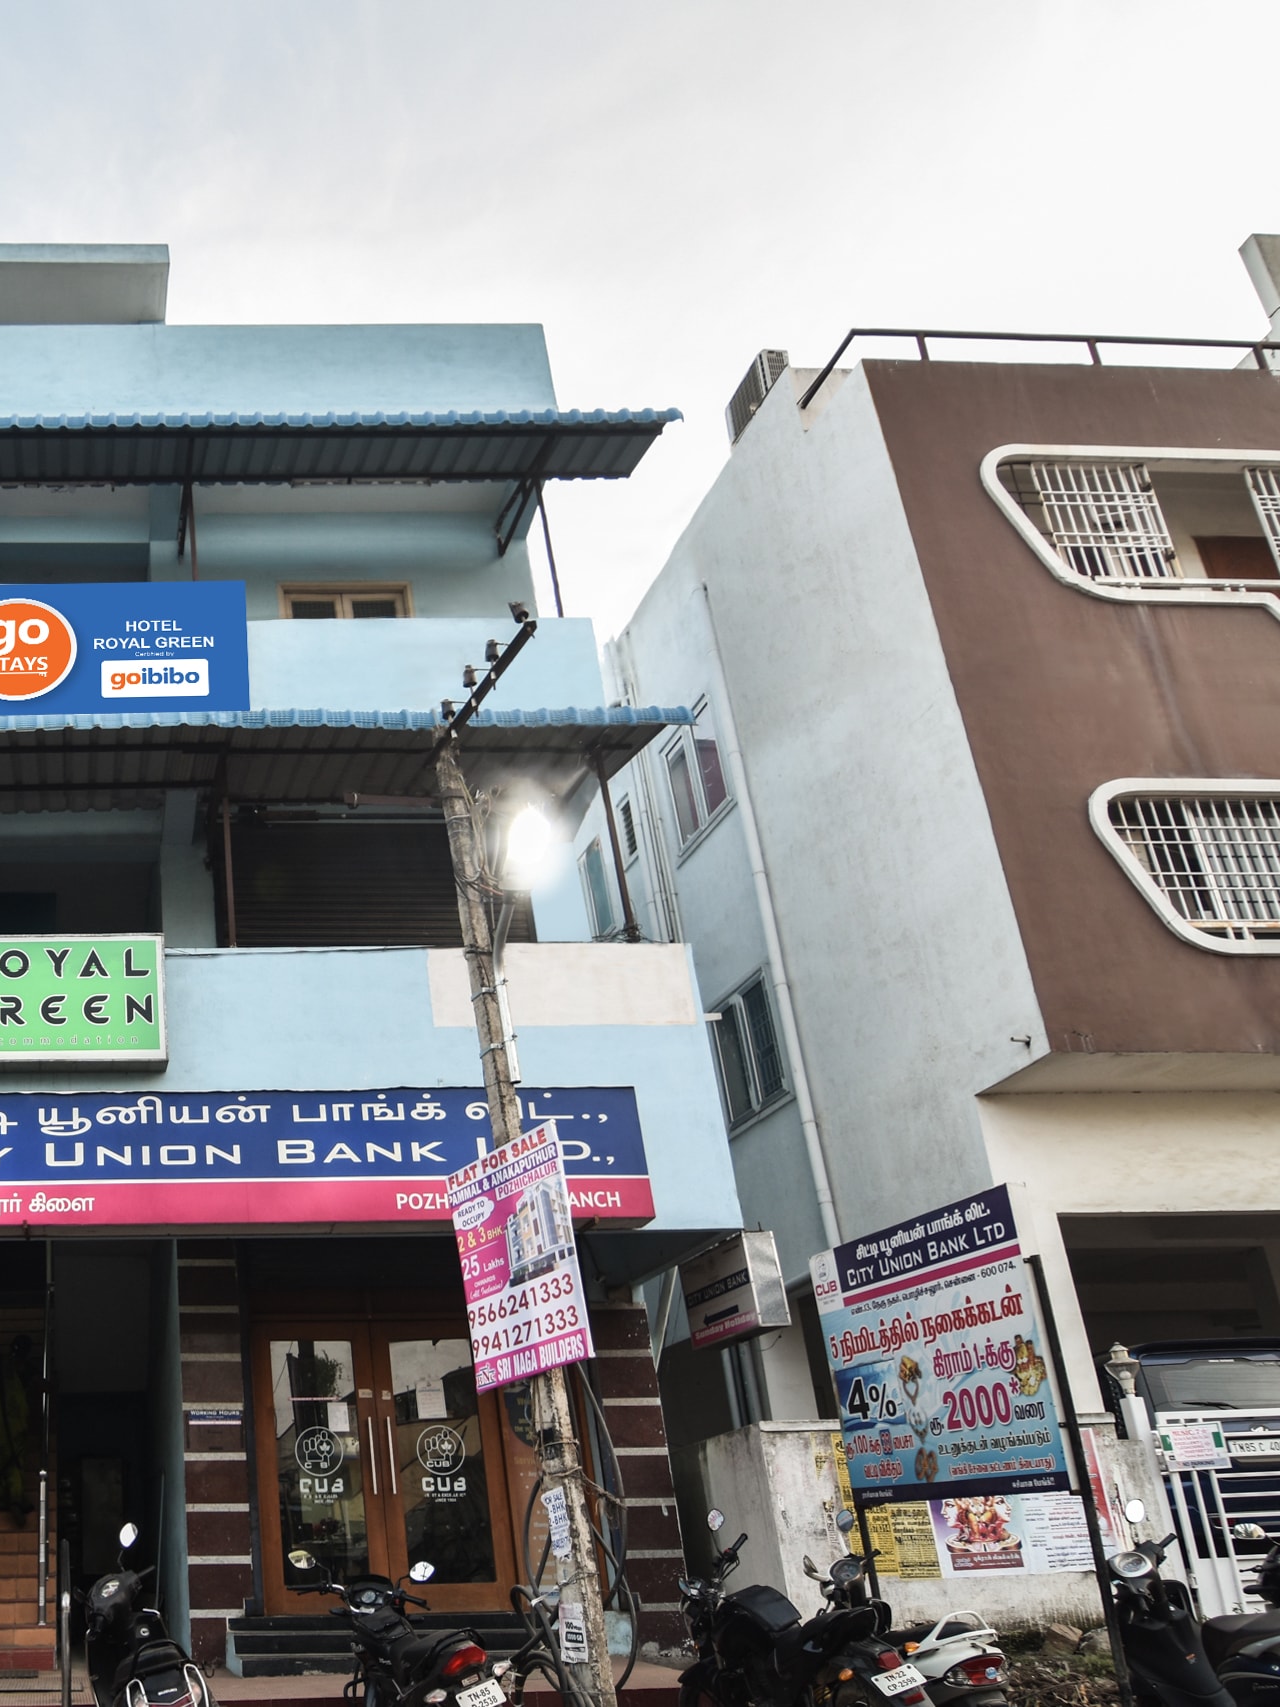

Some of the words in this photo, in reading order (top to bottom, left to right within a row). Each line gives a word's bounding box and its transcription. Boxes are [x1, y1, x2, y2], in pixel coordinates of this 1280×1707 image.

[125, 620, 182, 632] HOTEL
[94, 637, 150, 650] ROYAL
[156, 636, 214, 649] GREEN
[111, 667, 200, 690] goibibo
[38, 1094, 272, 1137] யூனியன்
[293, 1092, 446, 1123] பாங்க்
[45, 1142, 242, 1167] UNION
[277, 1138, 446, 1165] BANK
[448, 1164, 477, 1191] FLAT
[481, 1149, 509, 1174] FOR
[511, 1128, 547, 1158] SALE
[448, 1180, 482, 1206] PAMMAL
[482, 1178, 490, 1190] &
[491, 1144, 558, 1187] ANAKAPUTHUR
[498, 1161, 558, 1198] POZHICHALUR
[28, 1193, 95, 1213] கிளை
[457, 1203, 476, 1218] READY
[476, 1200, 485, 1210] TO
[462, 1212, 485, 1228] OCCUPY
[457, 1236, 465, 1253] 2
[468, 1231, 476, 1248] &
[478, 1227, 486, 1243] 3
[488, 1227, 503, 1240] BHK
[856, 1240, 878, 1260] சிட்டி
[879, 1221, 926, 1257] யூனியன்
[927, 1209, 964, 1236] பாங்க்
[846, 1263, 875, 1287] CITY
[880, 1248, 923, 1276] UNION
[928, 1232, 969, 1261] BANK
[974, 1221, 1006, 1246] LTD
[461, 1255, 481, 1281] 25
[483, 1257, 505, 1272] Lakhs
[727, 1271, 748, 1288] BANK
[980, 1266, 996, 1278] 600
[468, 1273, 574, 1330] 9566241333
[815, 1280, 838, 1297] CUB
[472, 1305, 579, 1359] 9941271333
[695, 1324, 724, 1340] Sunday
[839, 1311, 920, 1364] நிமிடத்தில்
[920, 1284, 1024, 1346] நகைக்கடன்
[496, 1357, 512, 1382] SRI
[514, 1349, 538, 1377] NAGA
[539, 1333, 585, 1368] BUILDERS
[932, 1343, 973, 1380] கிராம்
[847, 1376, 897, 1421] 4%
[1014, 1401, 1046, 1422] வரை
[854, 1434, 868, 1454] 100
[421, 1476, 467, 1492] CUB
[467, 1687, 491, 1702] TN-85
